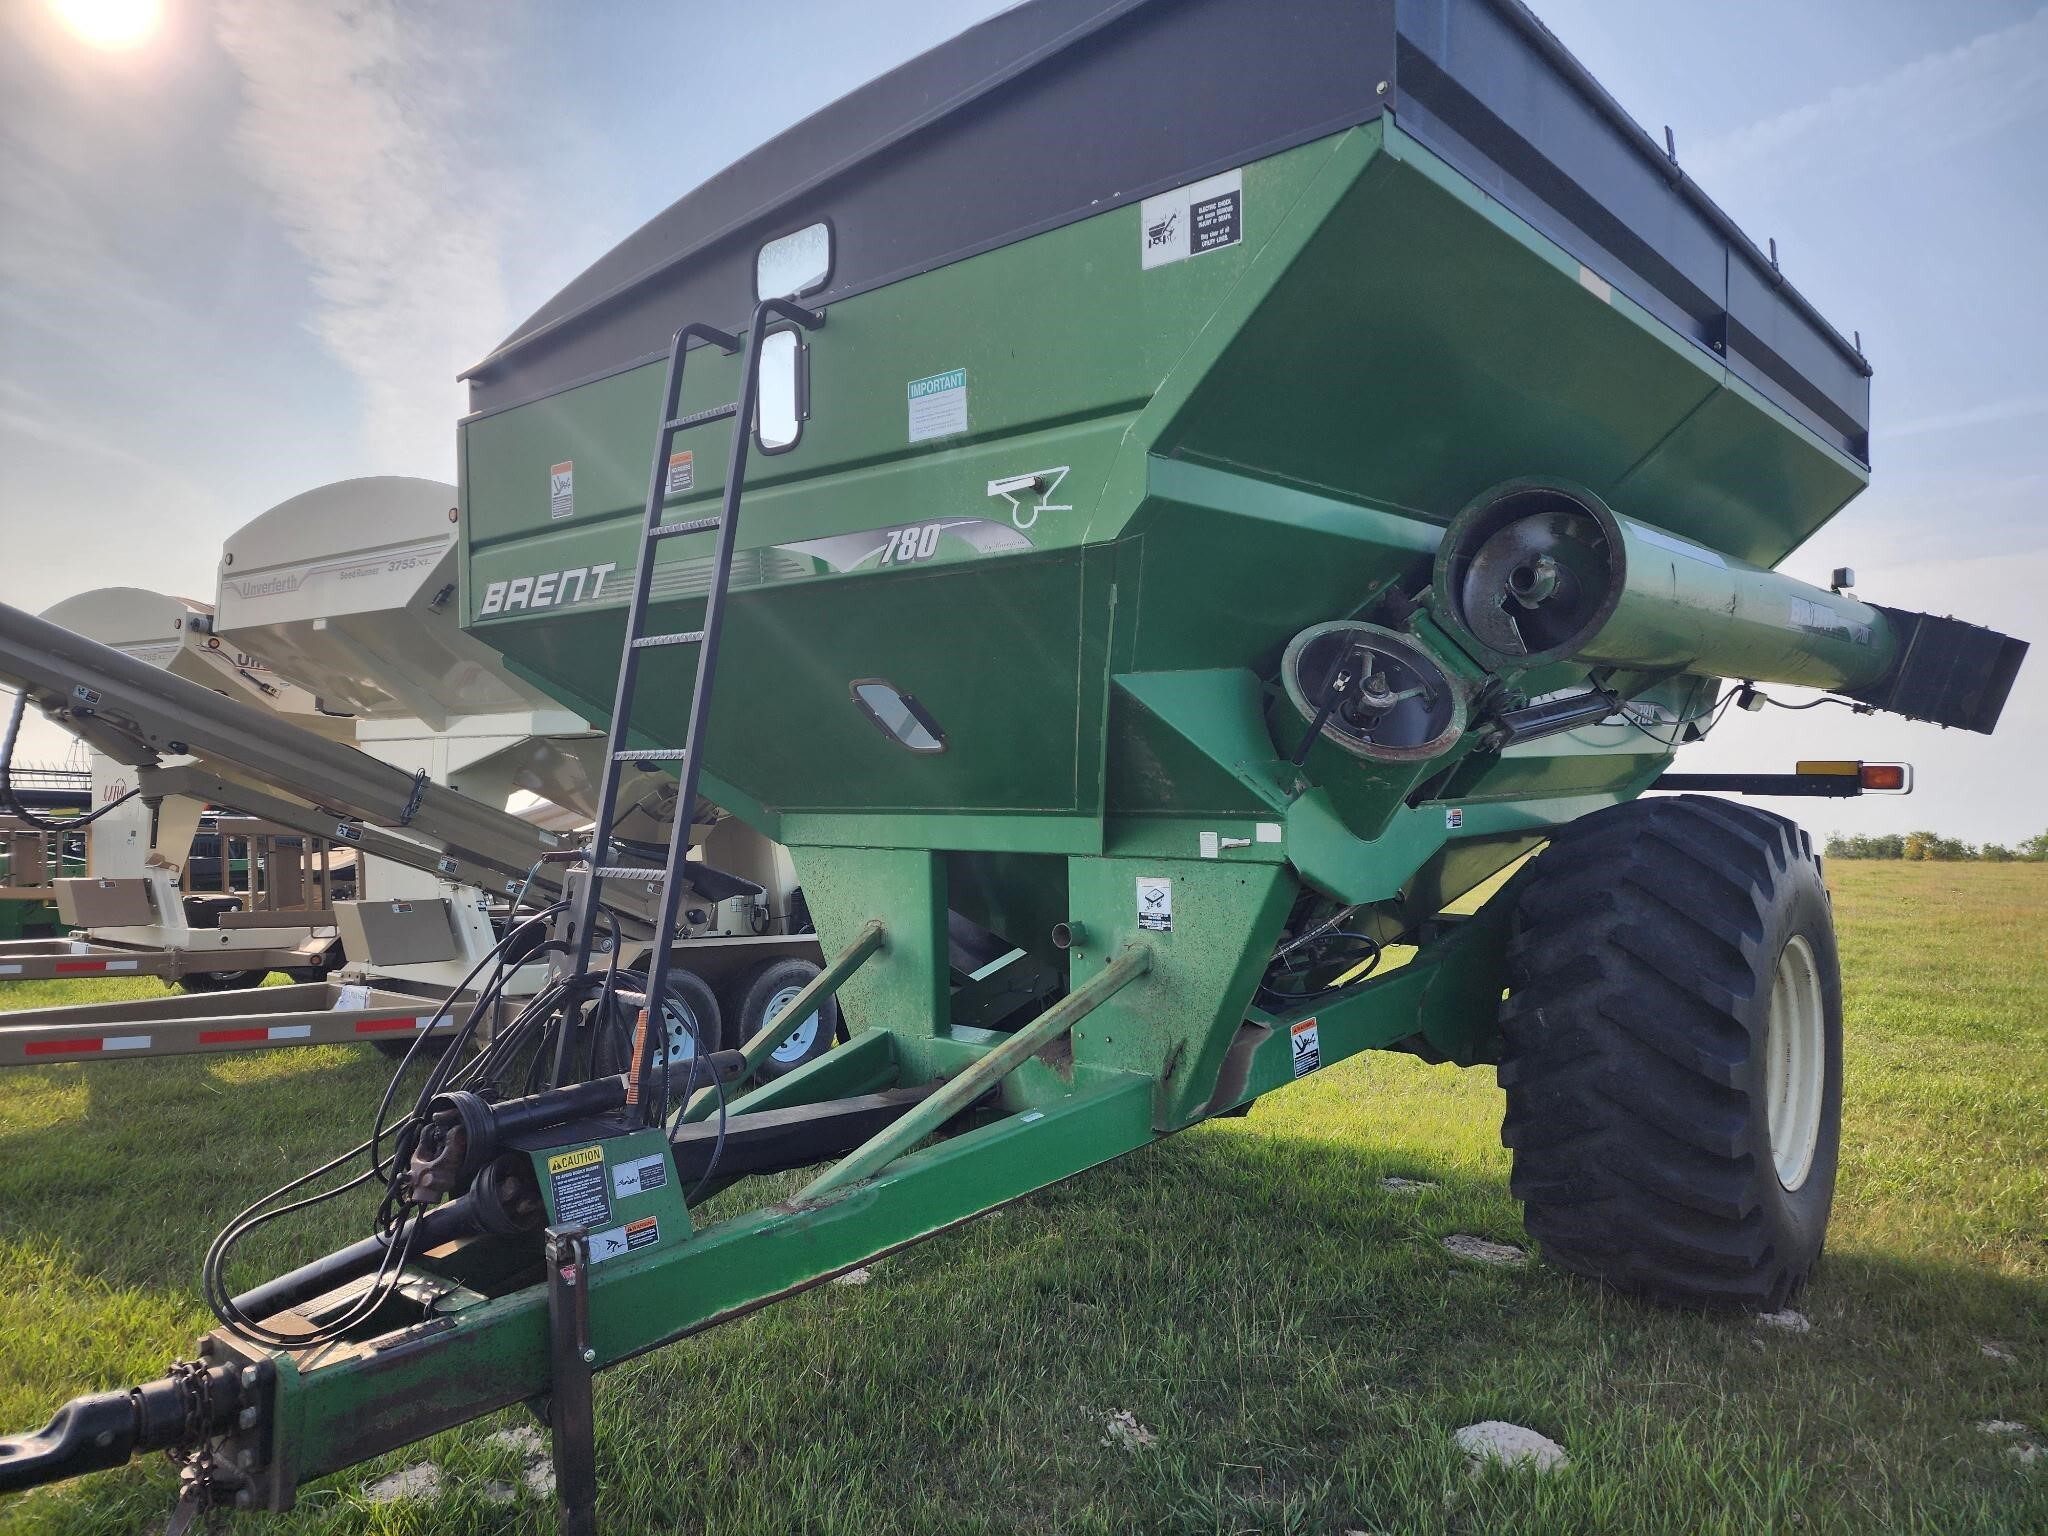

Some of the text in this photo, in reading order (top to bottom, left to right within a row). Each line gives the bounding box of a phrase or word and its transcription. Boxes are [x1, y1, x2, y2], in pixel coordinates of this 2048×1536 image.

[911, 372, 964, 398] IMPORTANT
[881, 523, 942, 564] 780
[242, 574, 299, 598] Unverferth
[480, 561, 617, 615] BRENT
[561, 1149, 601, 1168] CAUTION
